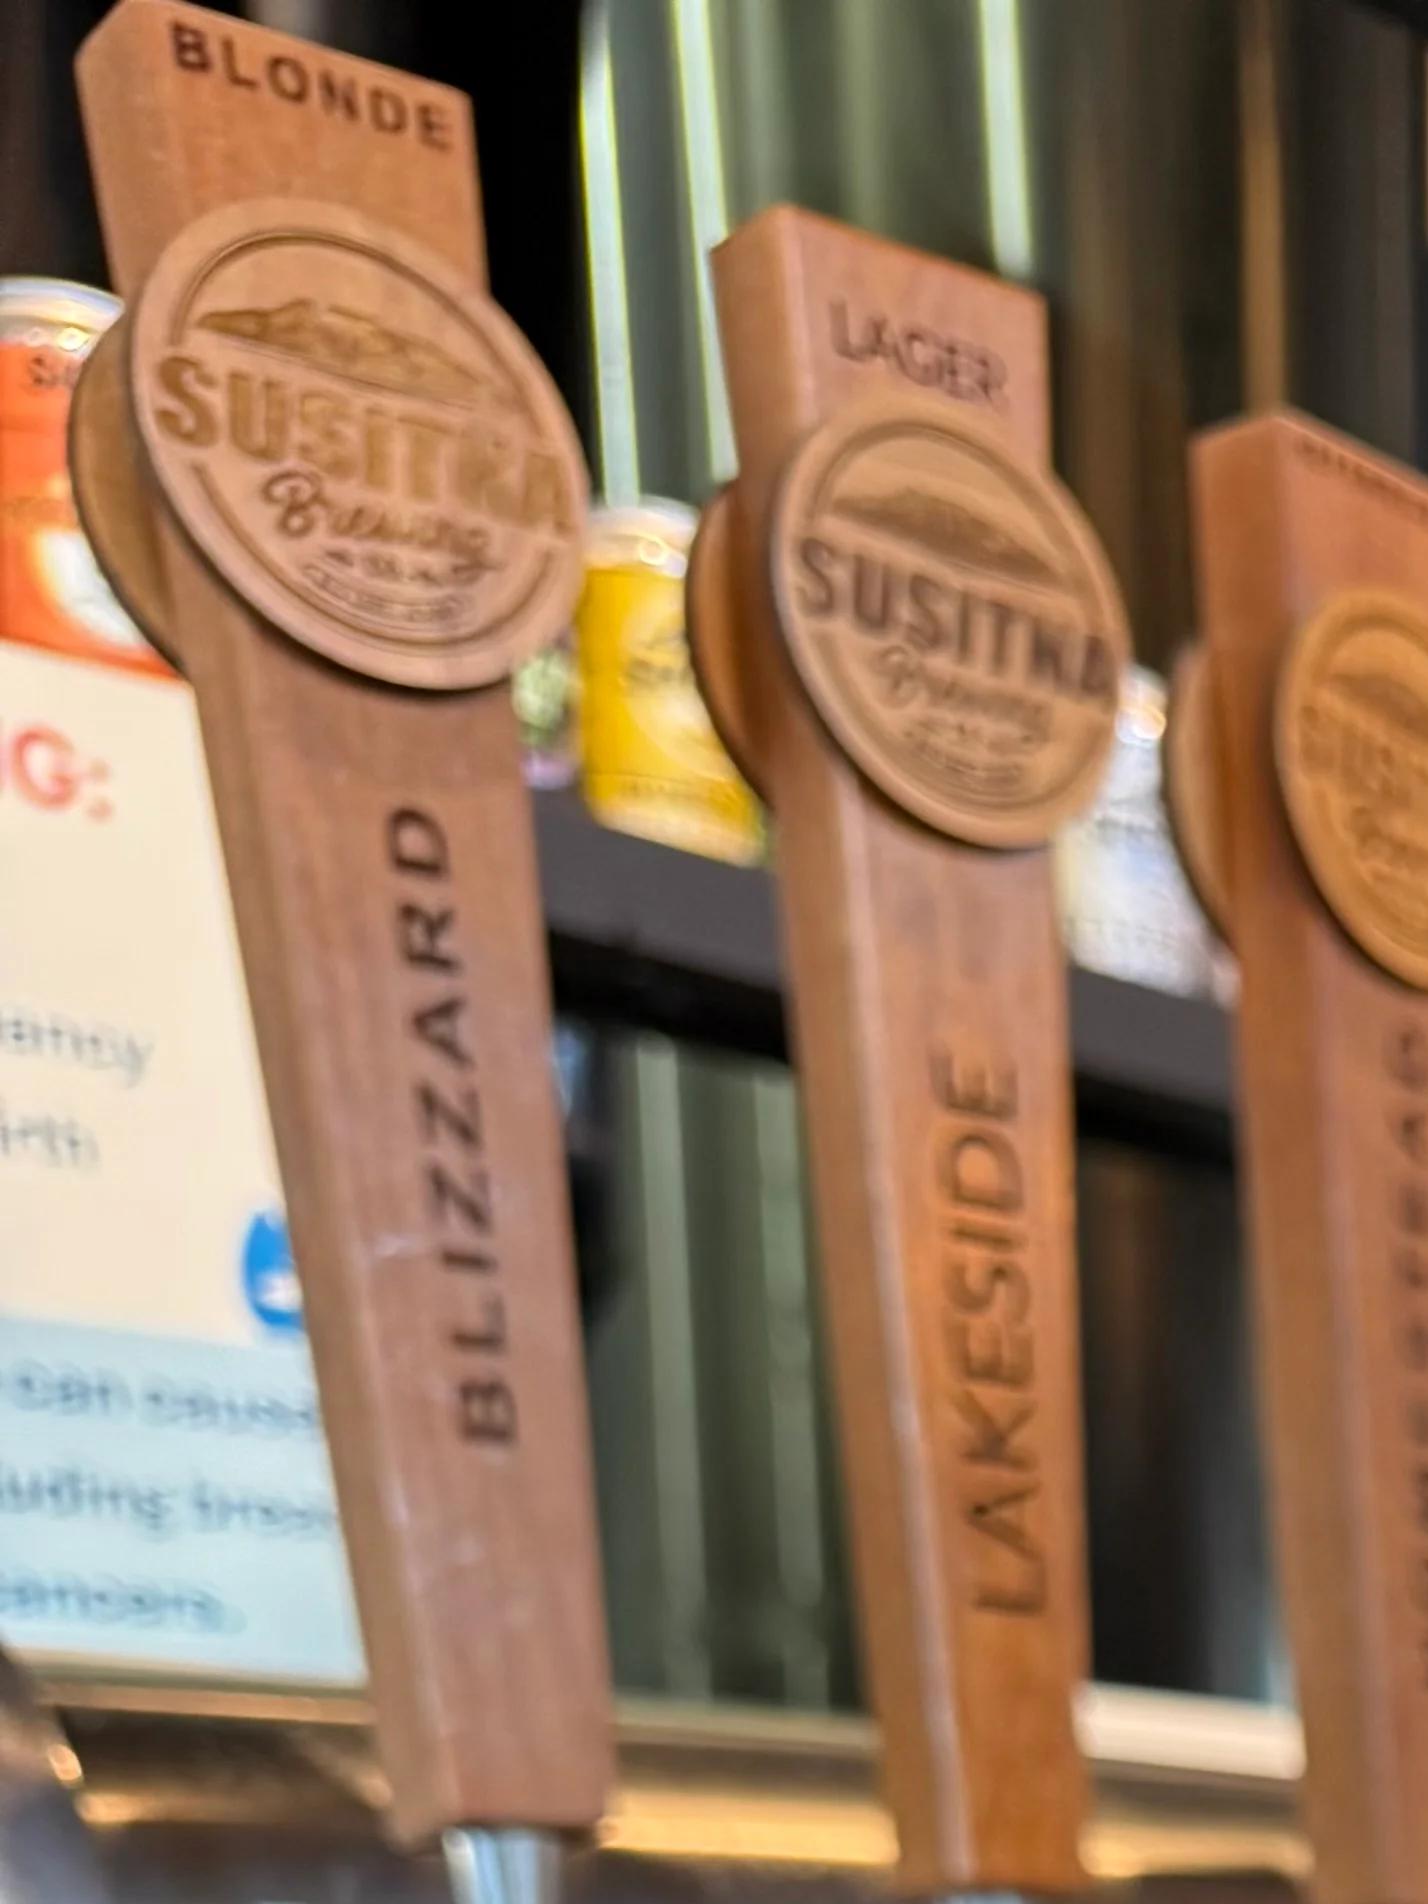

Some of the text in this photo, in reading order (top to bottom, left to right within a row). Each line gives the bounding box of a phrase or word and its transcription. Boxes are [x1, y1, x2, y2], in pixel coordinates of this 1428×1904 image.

[168, 18, 454, 156] BLONDE
[150, 354, 577, 548] SUSITNA
[829, 300, 1009, 410] LAGER
[384, 805, 519, 1447] BLIZZARD
[926, 1038, 1050, 1619] LAKESIDE
